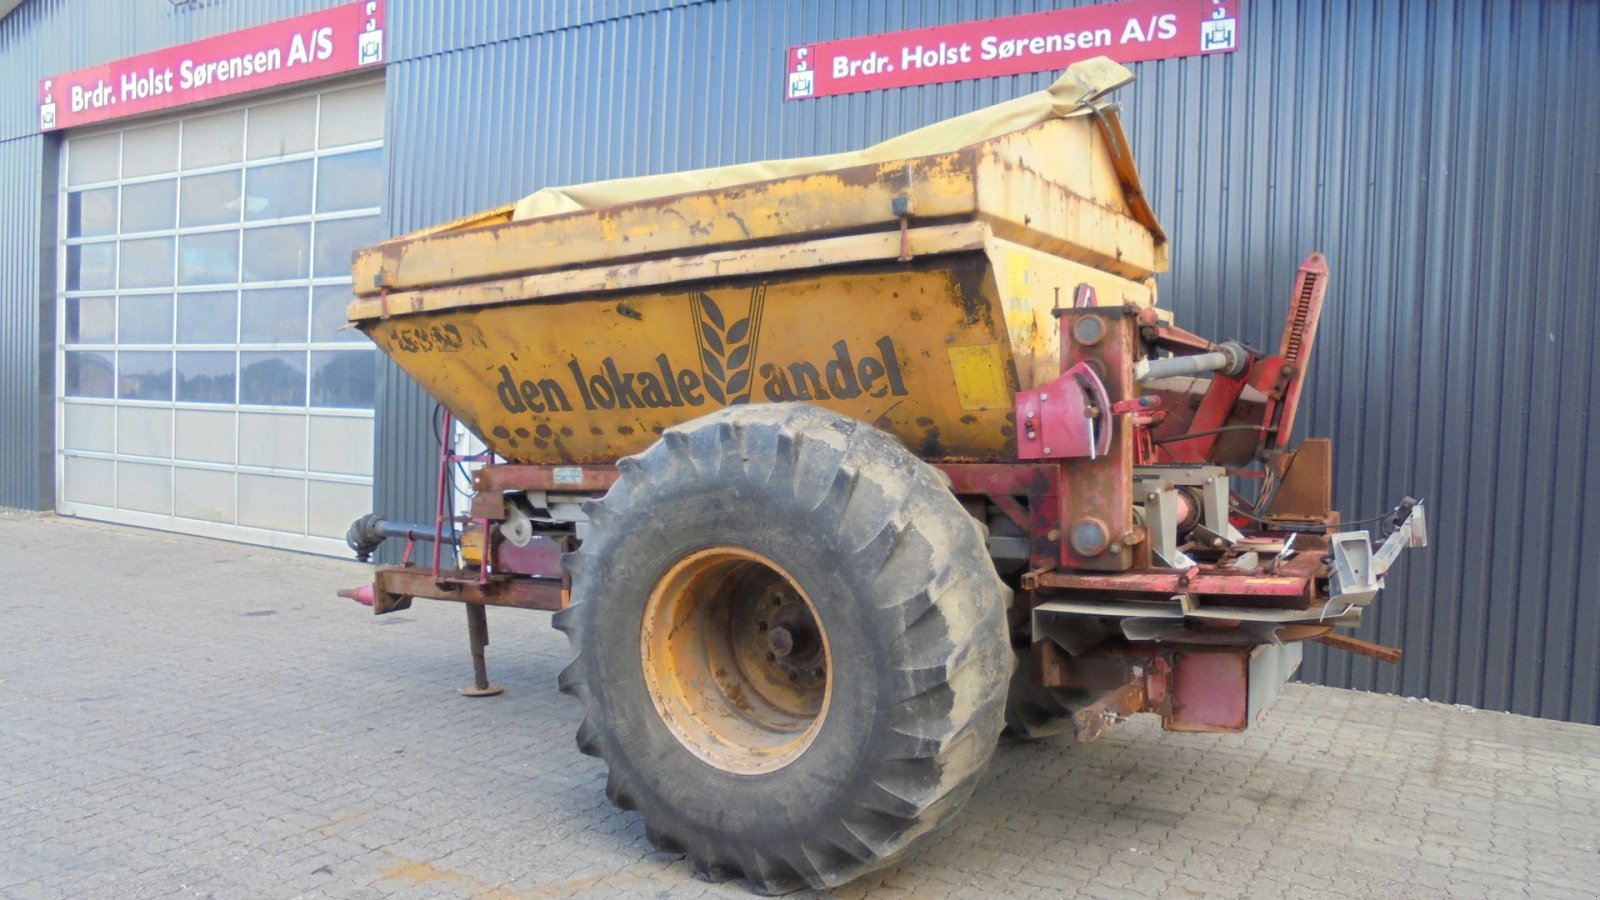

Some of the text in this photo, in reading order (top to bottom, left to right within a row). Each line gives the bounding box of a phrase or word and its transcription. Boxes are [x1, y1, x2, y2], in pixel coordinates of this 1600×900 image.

[71, 27, 333, 112] Brdr. Holst Sørensen A/S
[832, 14, 1177, 79] Brdr. Holst Sørensen A/S
[497, 335, 909, 414] den lokale andel
